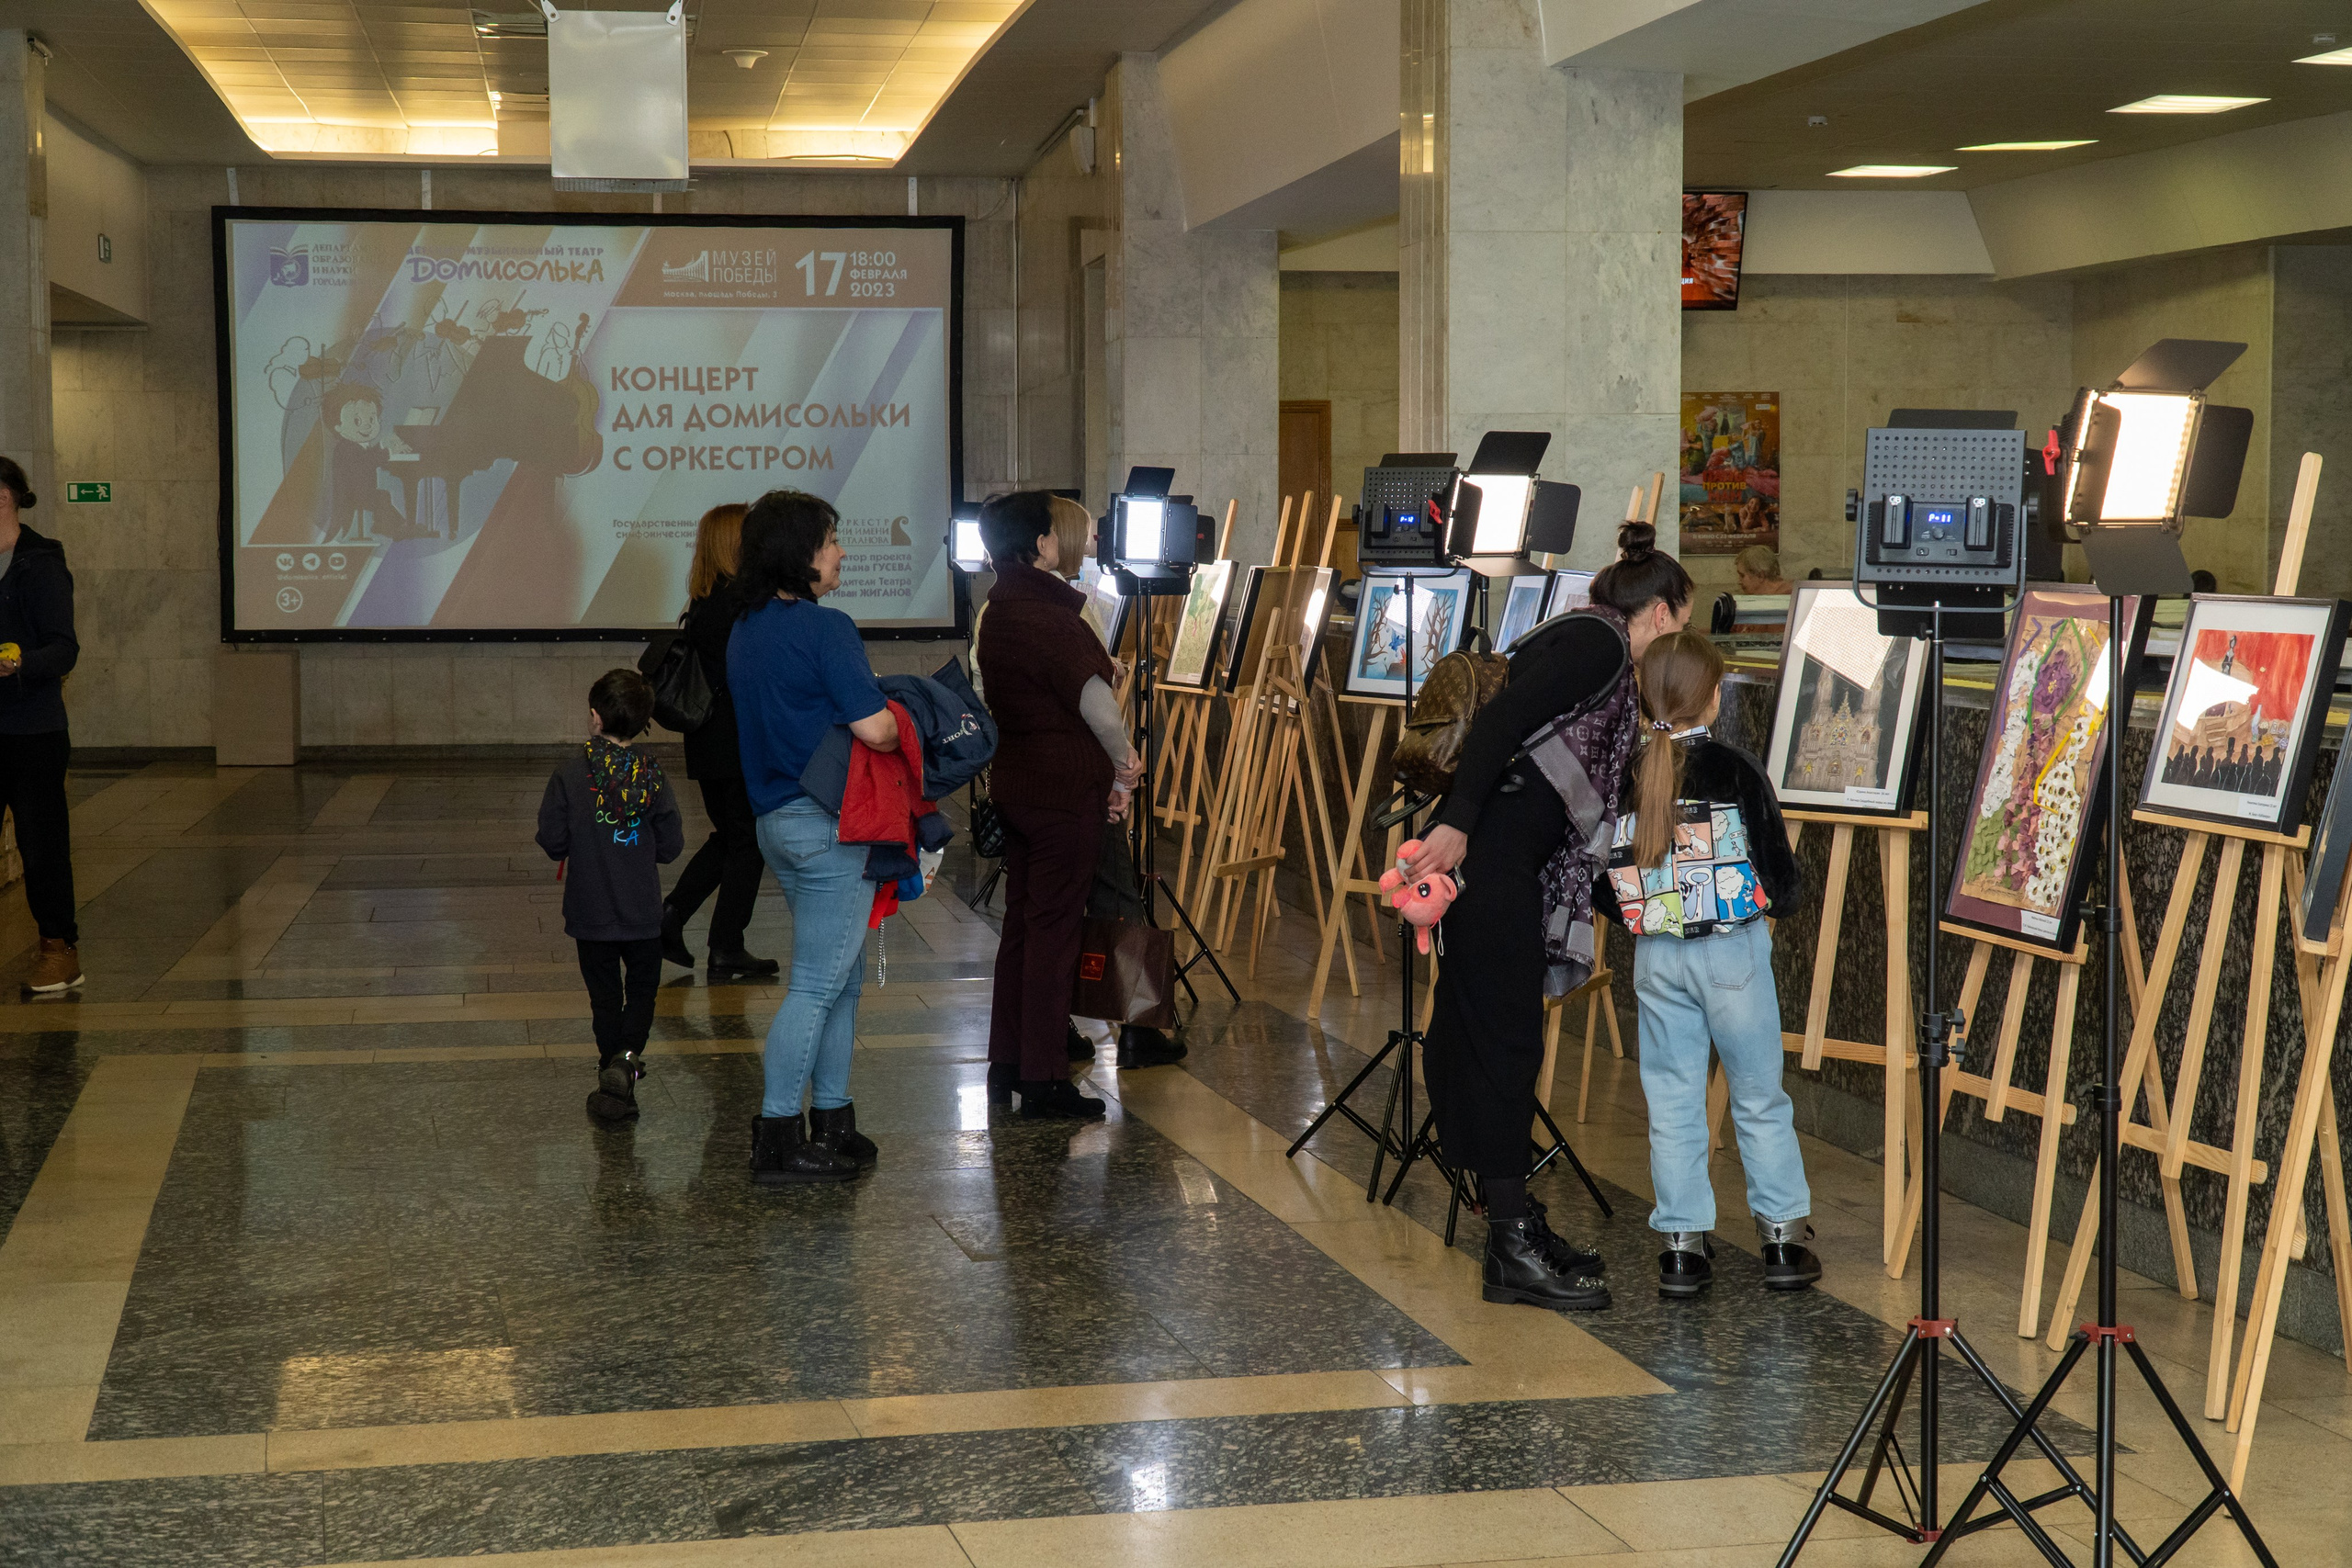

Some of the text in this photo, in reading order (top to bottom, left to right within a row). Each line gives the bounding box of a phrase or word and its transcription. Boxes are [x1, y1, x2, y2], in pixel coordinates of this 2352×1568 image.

[567, 247, 605, 256] ТЕАТР
[712, 248, 777, 266] МУЗЕЙ
[849, 251, 897, 266] 18:00
[712, 267, 777, 286] ПОБЕДЫ
[794, 249, 847, 297] 17
[849, 268, 908, 280] ФЕВРАЛЯ
[850, 282, 896, 298] 2023
[611, 366, 759, 396] КОНЦЕРТ
[612, 401, 910, 433] ДЛЯ ДОМИСОЛЬКИ
[613, 445, 835, 471] С ОРКЕСТРОМ
[1702, 480, 1747, 491] ПРОТИВ
[612, 518, 698, 529] Государственны
[855, 527, 889, 536] ИМЕНИ
[870, 554, 912, 563] проекта
[873, 562, 912, 572] ГУСЕВА
[878, 577, 912, 587] Театра
[281, 592, 300, 606] 3+
[832, 589, 857, 598] Иван
[860, 588, 911, 598] ЖИГАНОВ
